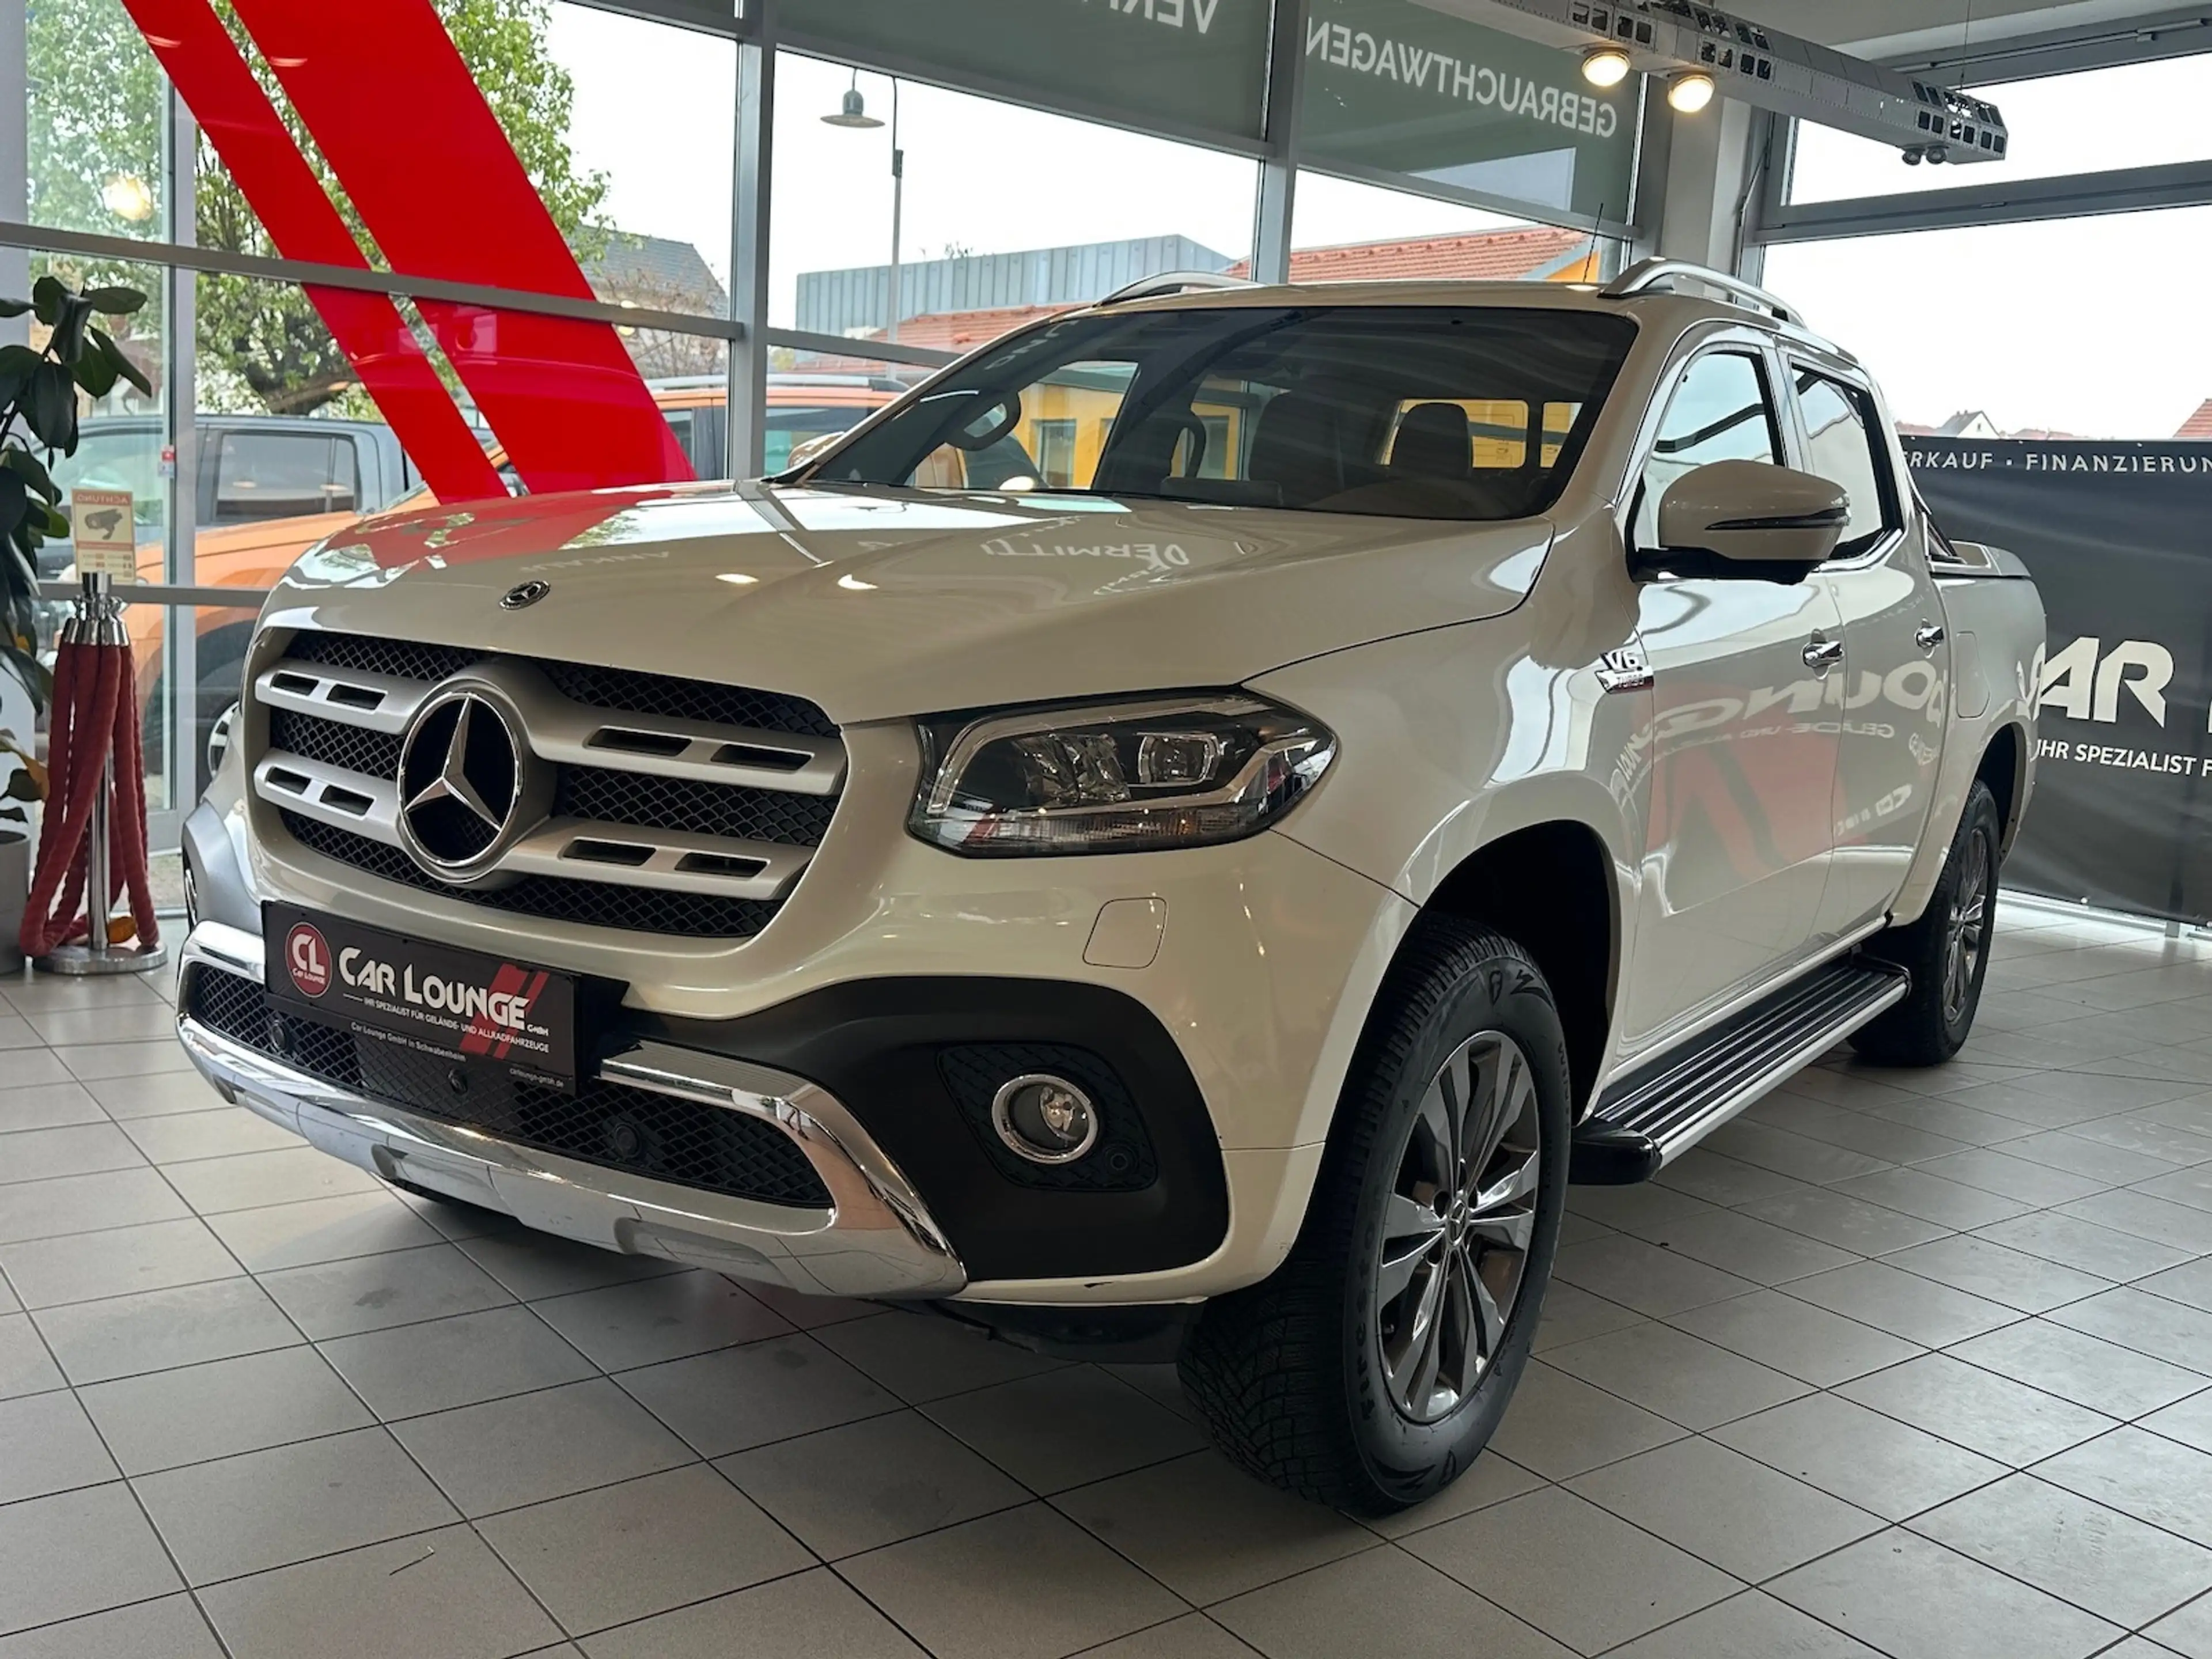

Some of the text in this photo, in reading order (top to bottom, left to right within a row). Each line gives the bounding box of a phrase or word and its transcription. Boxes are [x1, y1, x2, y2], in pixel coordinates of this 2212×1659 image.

[1903, 450, 1994, 469] RKAUF
[1604, 651, 1640, 671] V6
[2074, 743, 2196, 775] SPEZIALIST
[292, 933, 325, 975] CL
[339, 947, 396, 997] CAR
[404, 964, 530, 1030] LOUNGE
[350, 1021, 362, 1032] Car
[363, 1025, 386, 1041] Lounge
[387, 1032, 407, 1046] GmbH
[415, 1041, 467, 1062] Schwabenheim
[363, 997, 550, 1053] IHR SPEZIALIST FÜR GELÄNDE- UND ALLRADFAHRZEUGE
